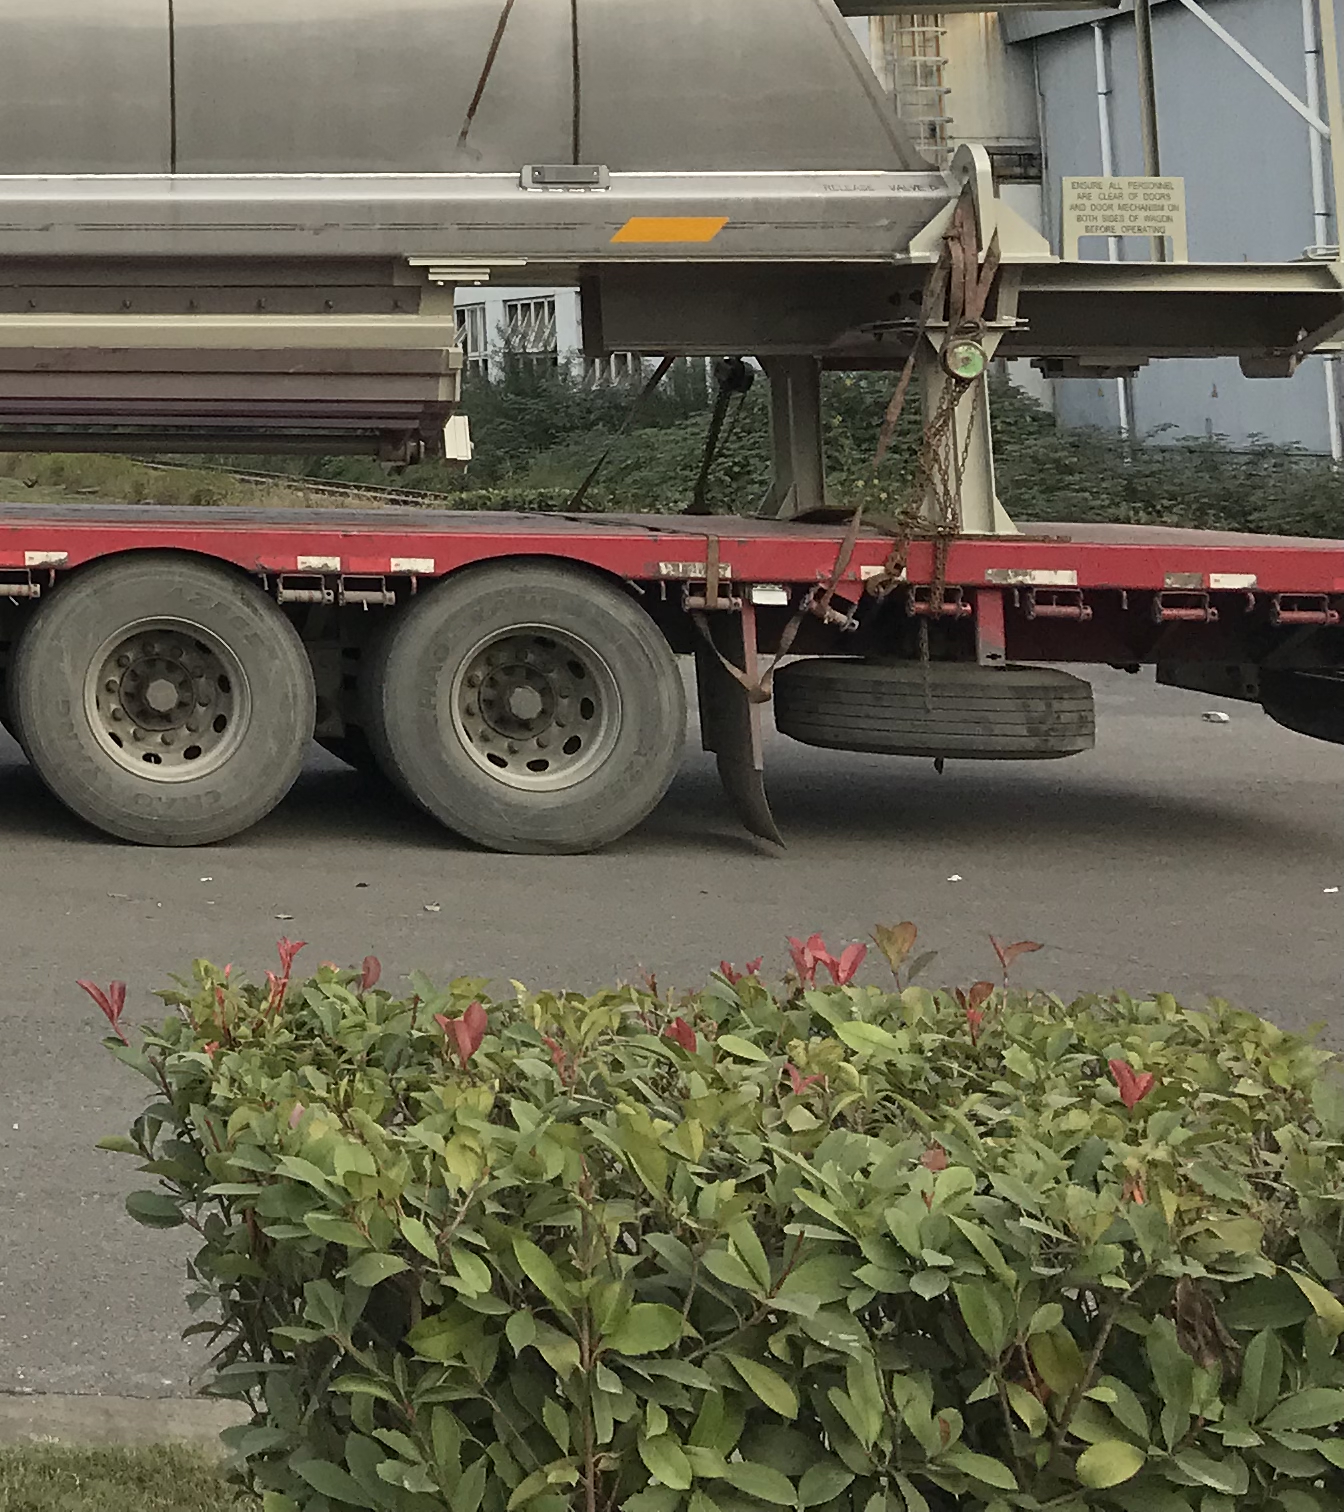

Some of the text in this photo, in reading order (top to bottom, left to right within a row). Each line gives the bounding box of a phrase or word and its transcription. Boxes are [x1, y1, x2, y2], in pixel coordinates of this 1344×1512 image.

[1108, 181, 1122, 190] ALL
[1077, 192, 1171, 201] ARE CLEAR OF DOORS
[1090, 203, 1114, 211] DOOR
[1167, 203, 1180, 211] ON
[1076, 214, 1098, 223] BOTH
[1128, 214, 1139, 223] OF
